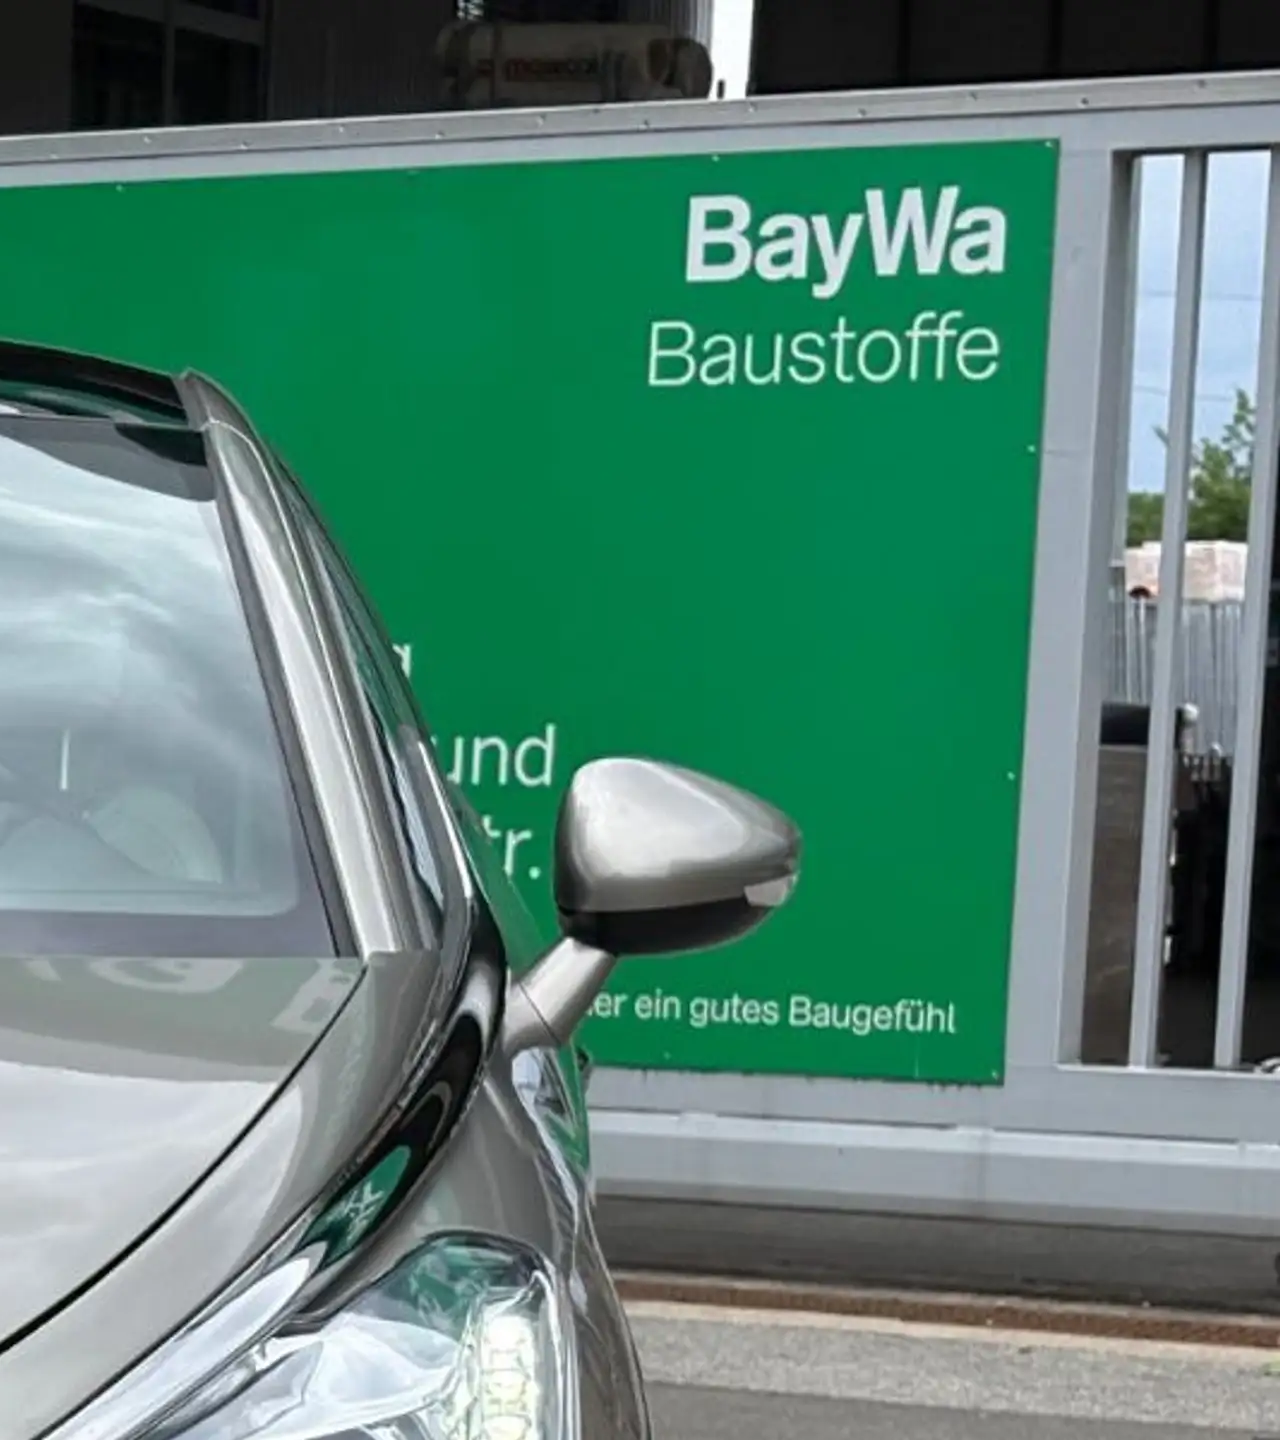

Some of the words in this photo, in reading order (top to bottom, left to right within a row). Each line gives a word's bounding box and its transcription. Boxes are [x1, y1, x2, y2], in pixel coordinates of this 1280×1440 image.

[685, 185, 1007, 300] BayWa
[648, 310, 1000, 386] Baustoffe
[635, 988, 681, 1020] ein
[689, 993, 780, 1029] gutes
[788, 995, 957, 1035] Baugefühl
